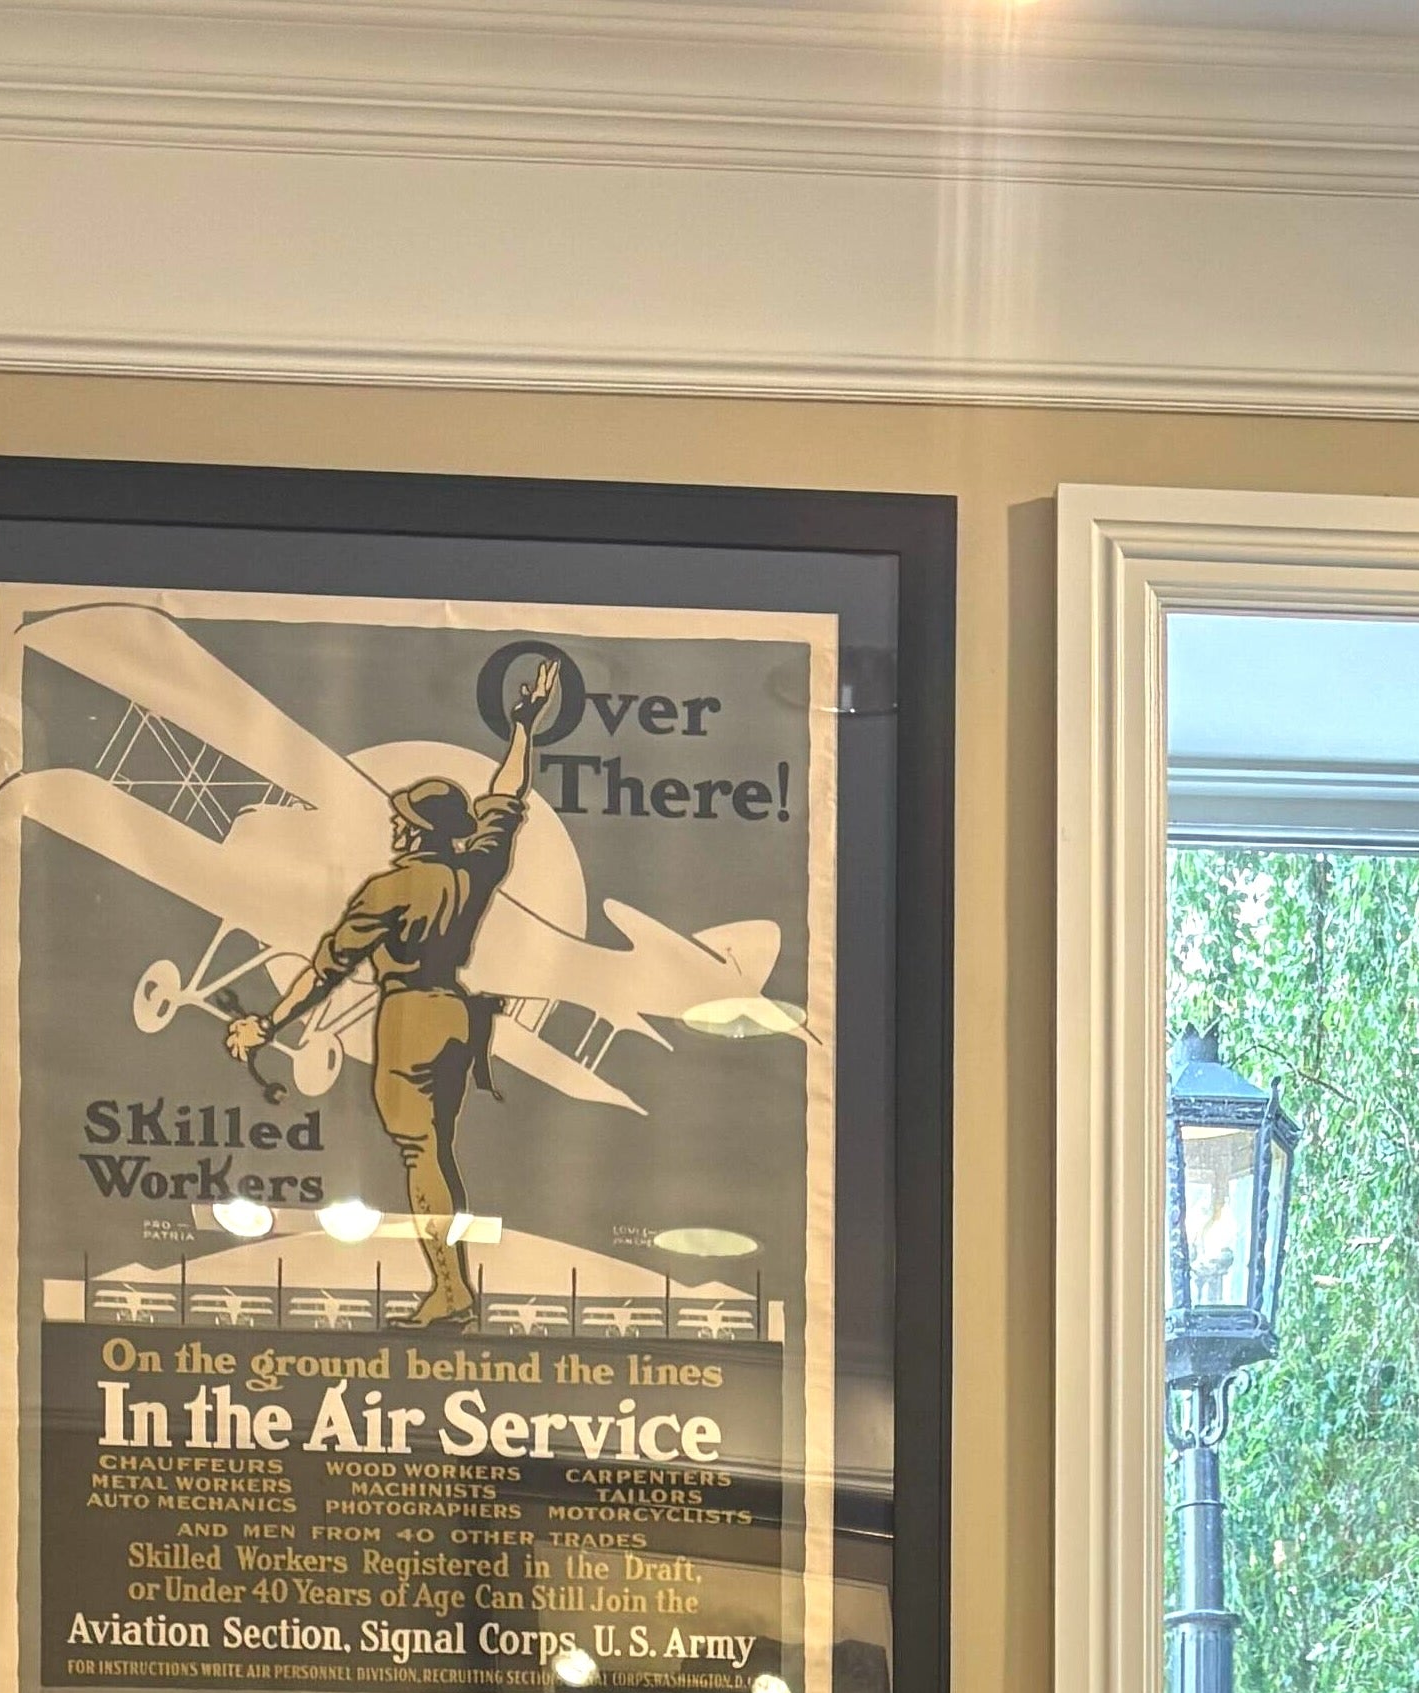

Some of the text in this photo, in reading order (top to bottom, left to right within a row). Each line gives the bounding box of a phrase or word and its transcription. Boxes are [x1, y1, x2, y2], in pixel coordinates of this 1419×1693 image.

[476, 641, 722, 746] Over
[540, 756, 792, 822] There!
[144, 1231, 194, 1240] PATRIA
[102, 1337, 723, 1391] On the ground behind the lines
[98, 1380, 723, 1461] In the Air Service
[98, 1455, 284, 1475] CHAUFFEURS
[325, 1460, 522, 1482] WOOD WORKERS
[91, 1475, 292, 1494] METAL WORKERS
[565, 1467, 733, 1487] CARPENTERS
[351, 1482, 497, 1499] MACHINISTS
[596, 1488, 703, 1505] TAILORS
[87, 1494, 297, 1513] AUTO MECHANICS
[325, 1500, 522, 1520] PHOTOGRAPHERS
[548, 1505, 752, 1526] MOTORCYCLISTS
[177, 1523, 648, 1548] AND MEN FROM 40 OTHER TRADES
[128, 1543, 702, 1585] Skilled Workers Registered in the Draft,
[128, 1575, 698, 1613] or Under 40 Years of Age Can Still Join the
[68, 1612, 755, 1667] Aviation Section, Signal U. S. Army
[68, 1660, 503, 1684] FOR INSTRUCTIONS WRITE AIR PERSONNEL RECRUITING
